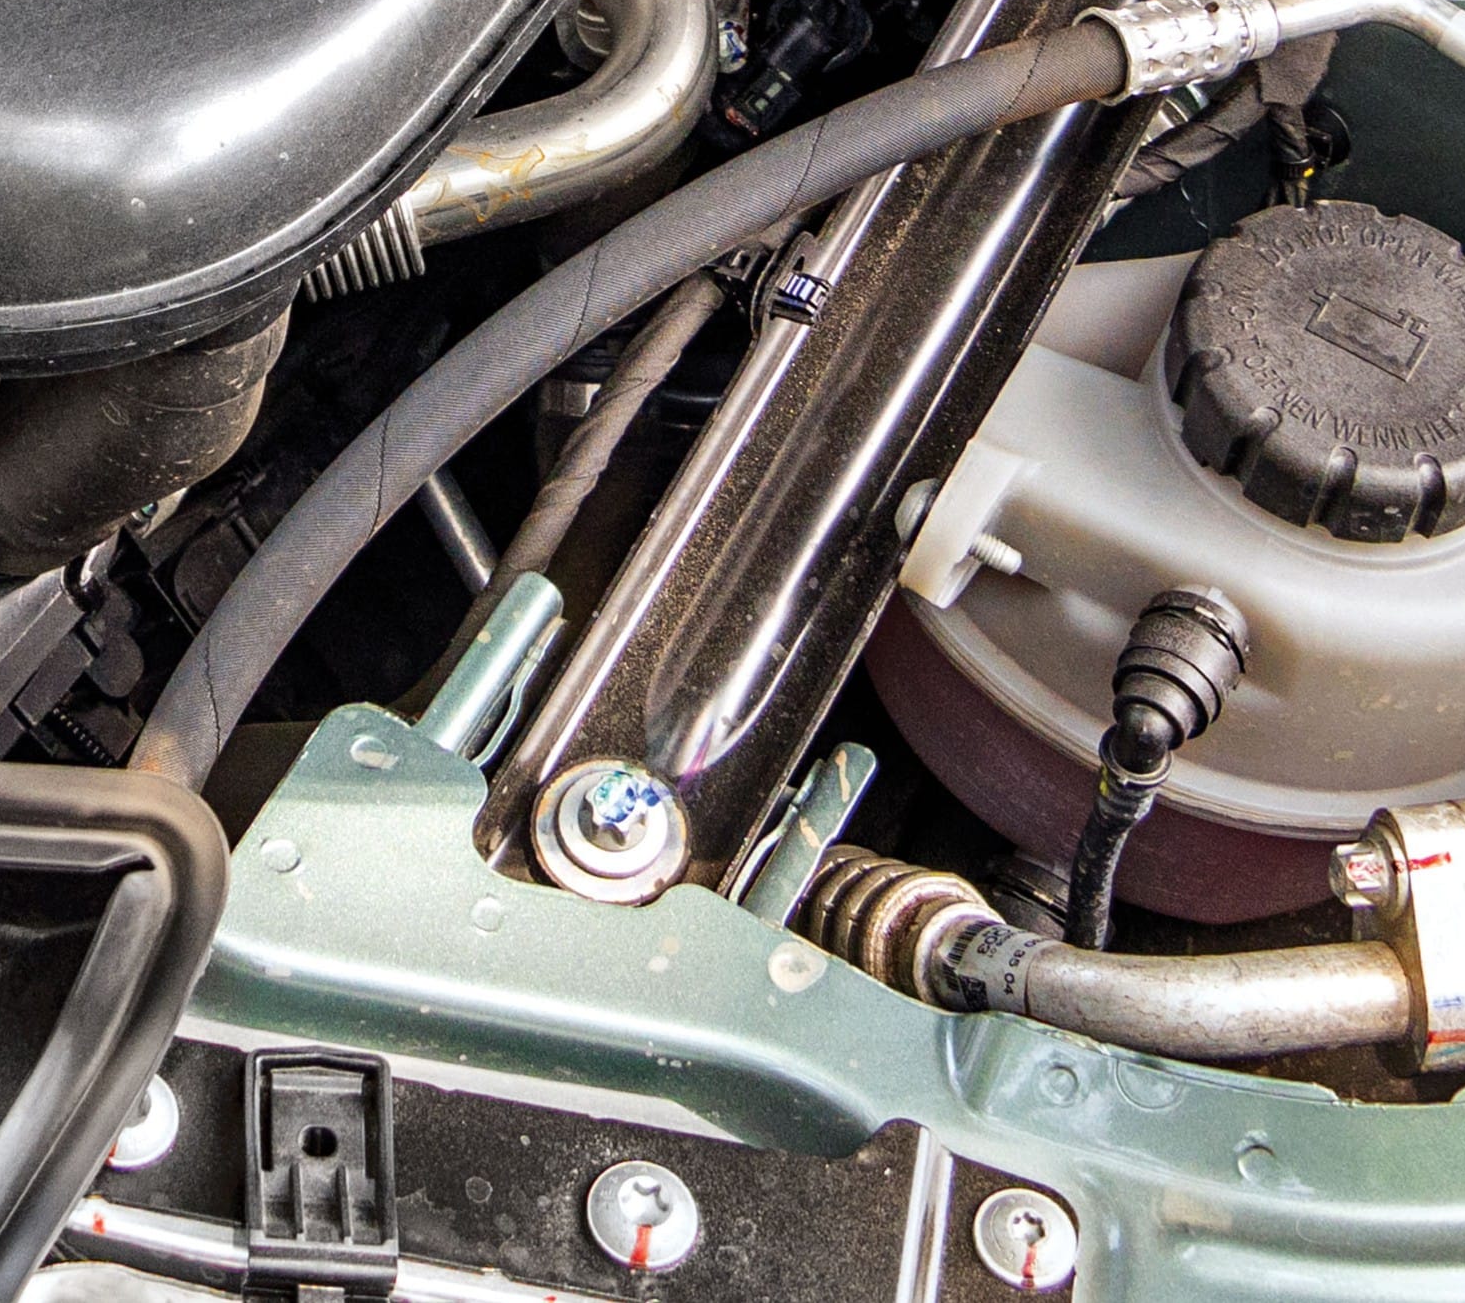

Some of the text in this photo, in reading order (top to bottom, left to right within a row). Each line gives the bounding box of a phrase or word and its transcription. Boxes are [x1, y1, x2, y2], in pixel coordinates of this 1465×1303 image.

[1360, 226, 1434, 270] OPEN
[1332, 415, 1410, 452] WENN
[1004, 972, 1015, 996] 04
